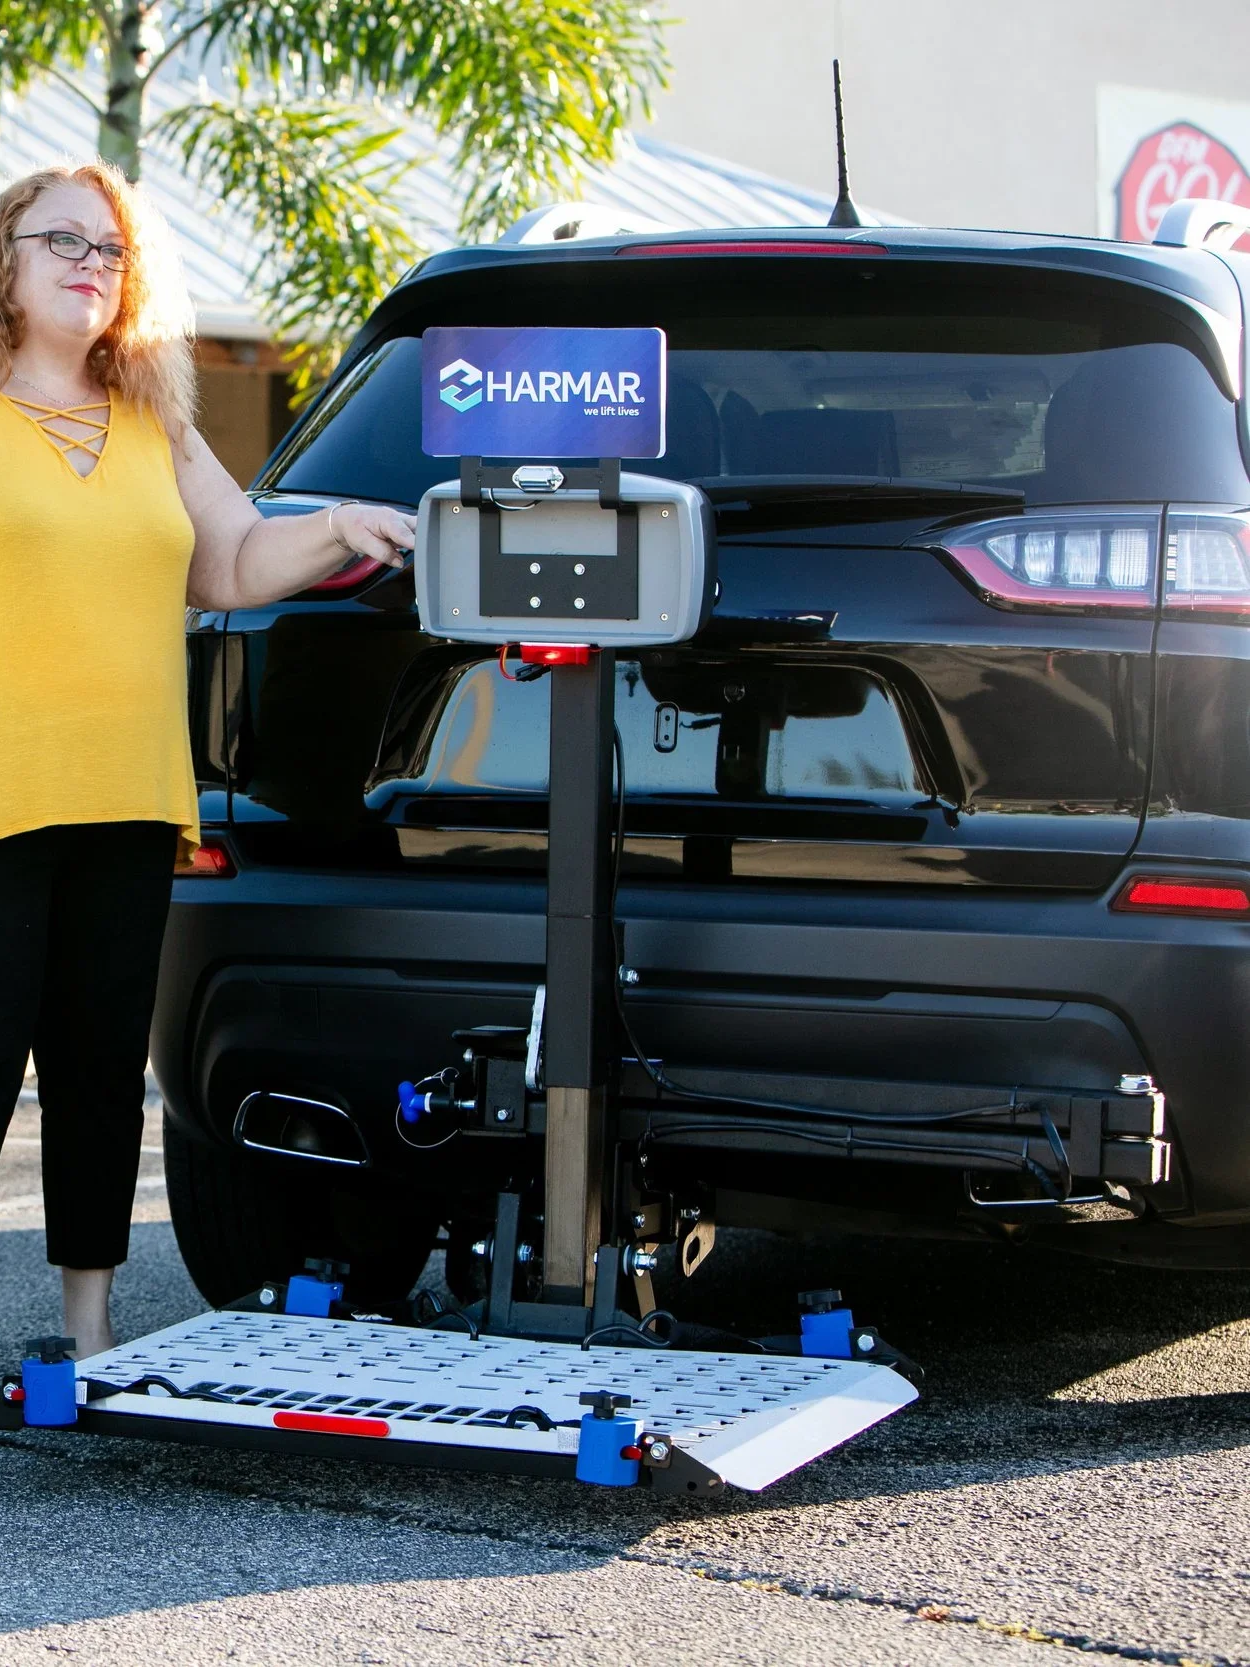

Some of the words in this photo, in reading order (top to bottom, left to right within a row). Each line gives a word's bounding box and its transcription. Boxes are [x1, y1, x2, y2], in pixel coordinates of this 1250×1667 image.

[584, 408, 599, 416] we
[601, 406, 616, 416] lift
[618, 406, 640, 416] lives
